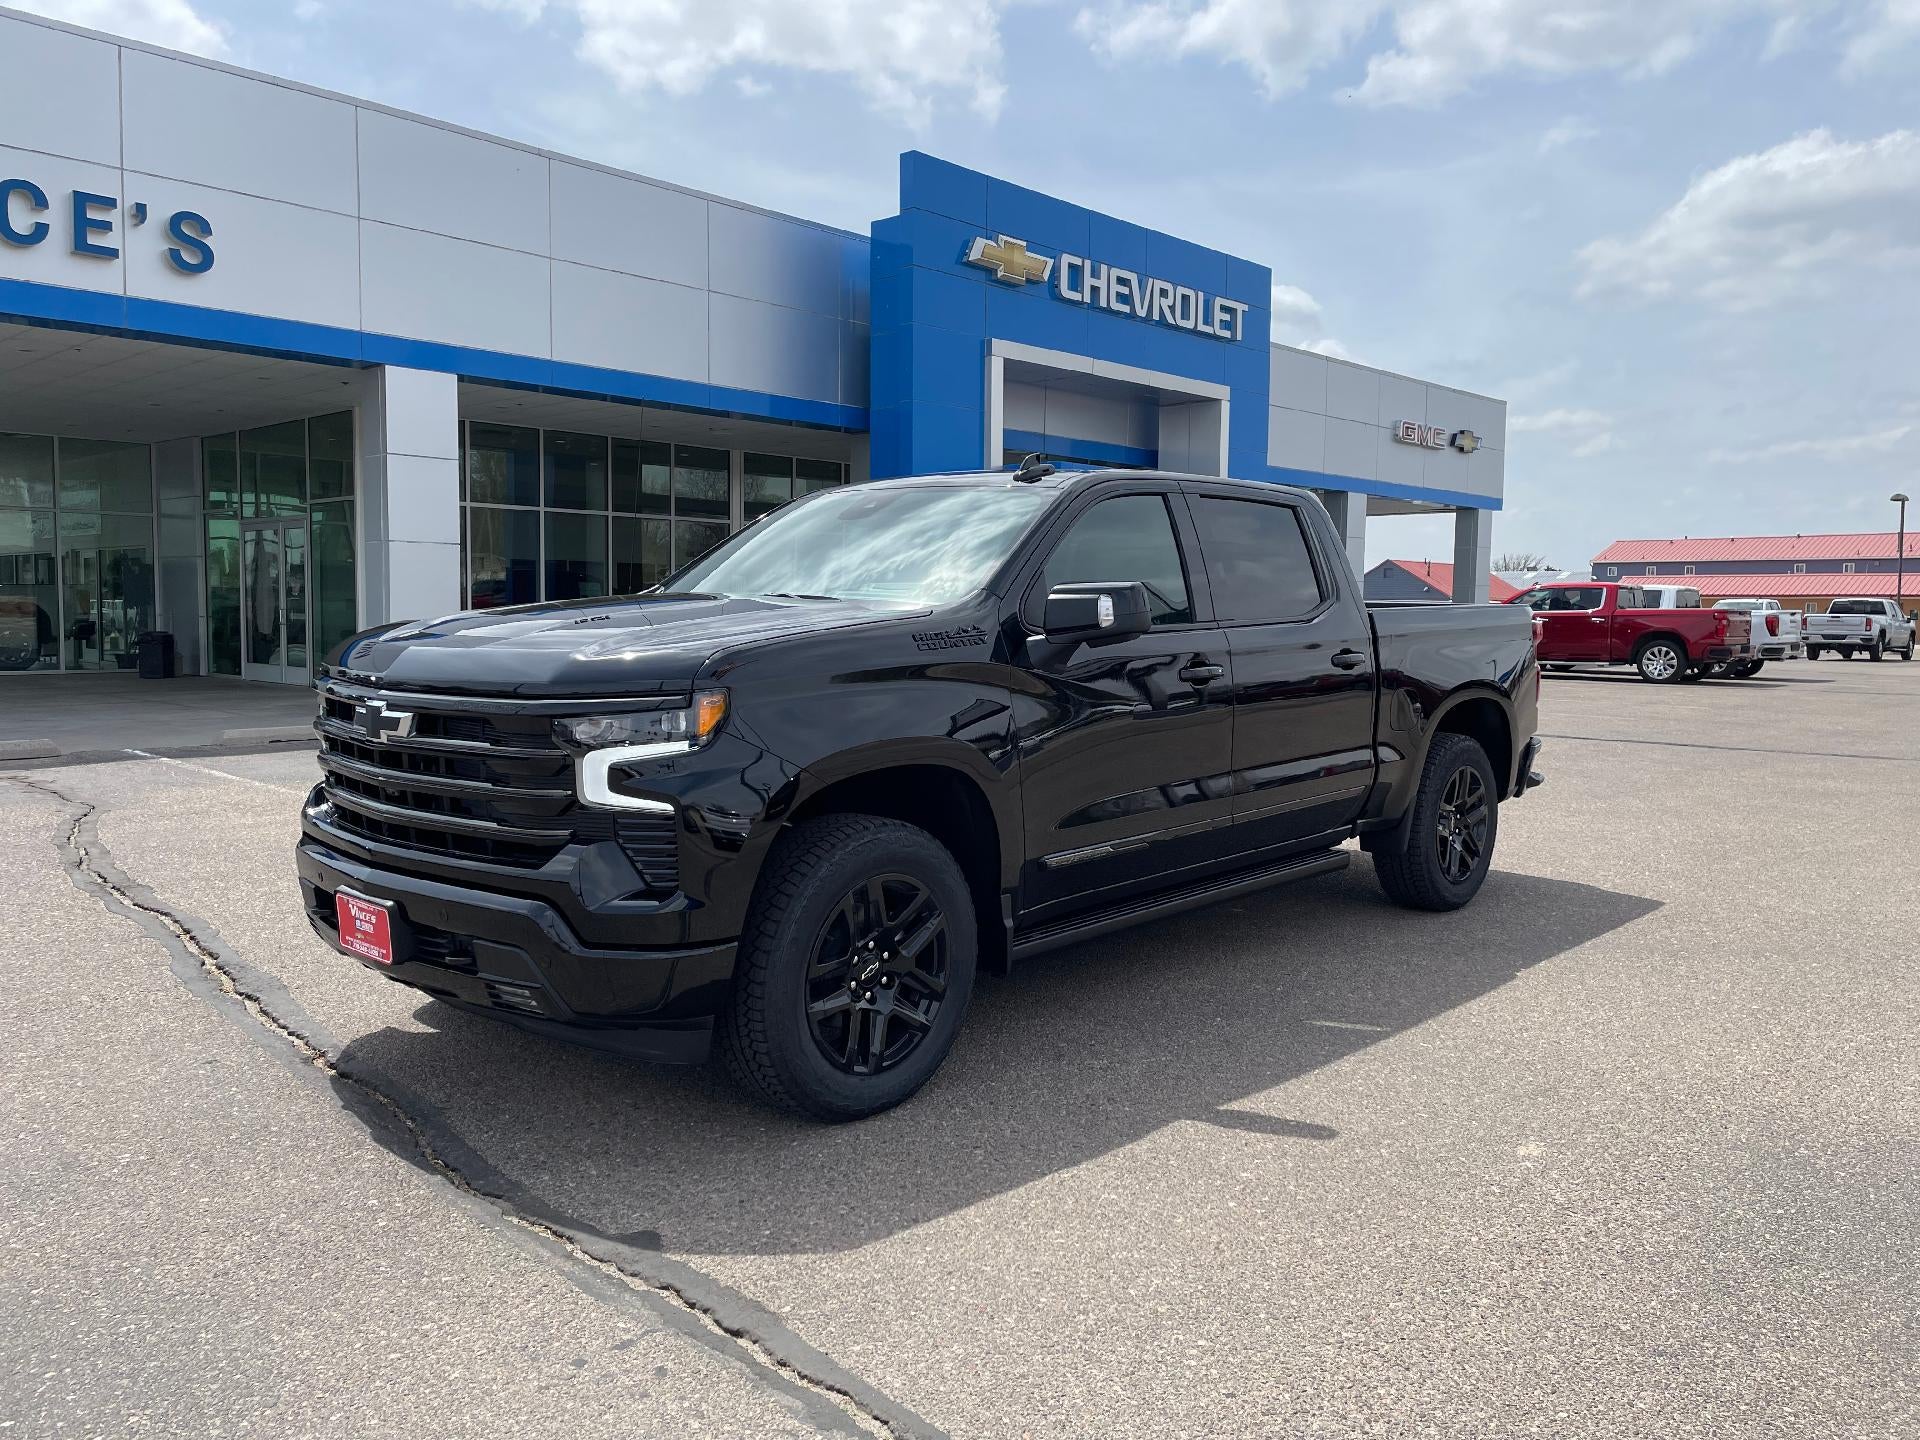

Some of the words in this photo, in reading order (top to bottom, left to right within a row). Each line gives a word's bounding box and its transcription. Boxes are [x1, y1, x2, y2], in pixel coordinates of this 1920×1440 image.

[1058, 253, 1249, 341] CHEVROLET
[1397, 419, 1447, 449] GMC
[917, 636, 988, 651] COUNTRY
